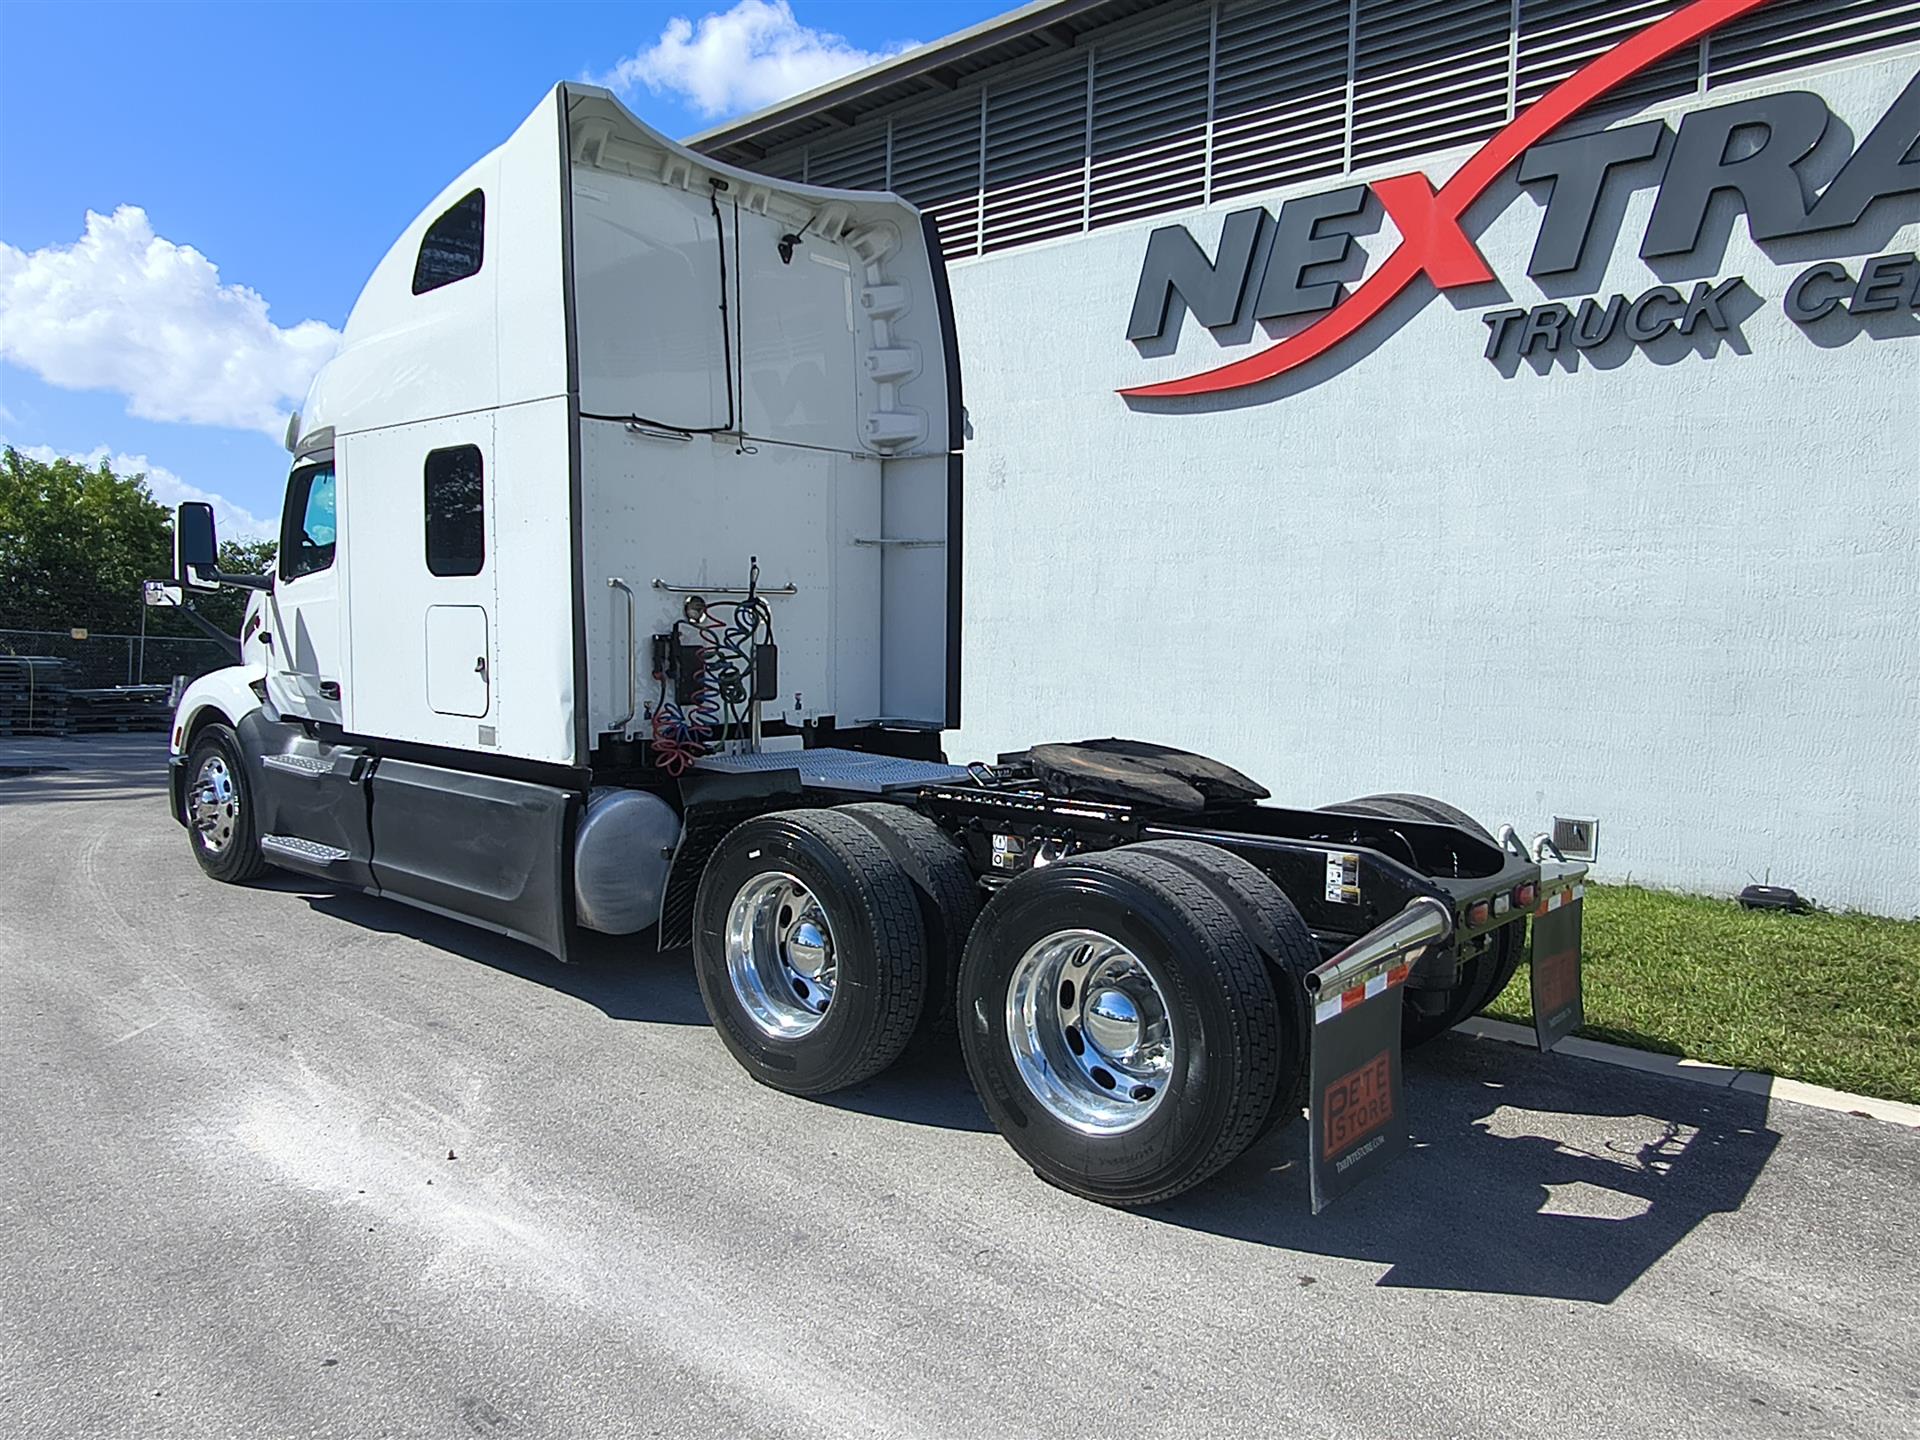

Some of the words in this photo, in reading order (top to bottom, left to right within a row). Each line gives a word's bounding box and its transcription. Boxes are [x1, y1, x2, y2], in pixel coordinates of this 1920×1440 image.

[1482, 276, 1744, 360] TRUCK
[1783, 251, 1920, 325] CE
[1327, 1058, 1387, 1148] PETE
[1335, 1094, 1388, 1141] STORE
